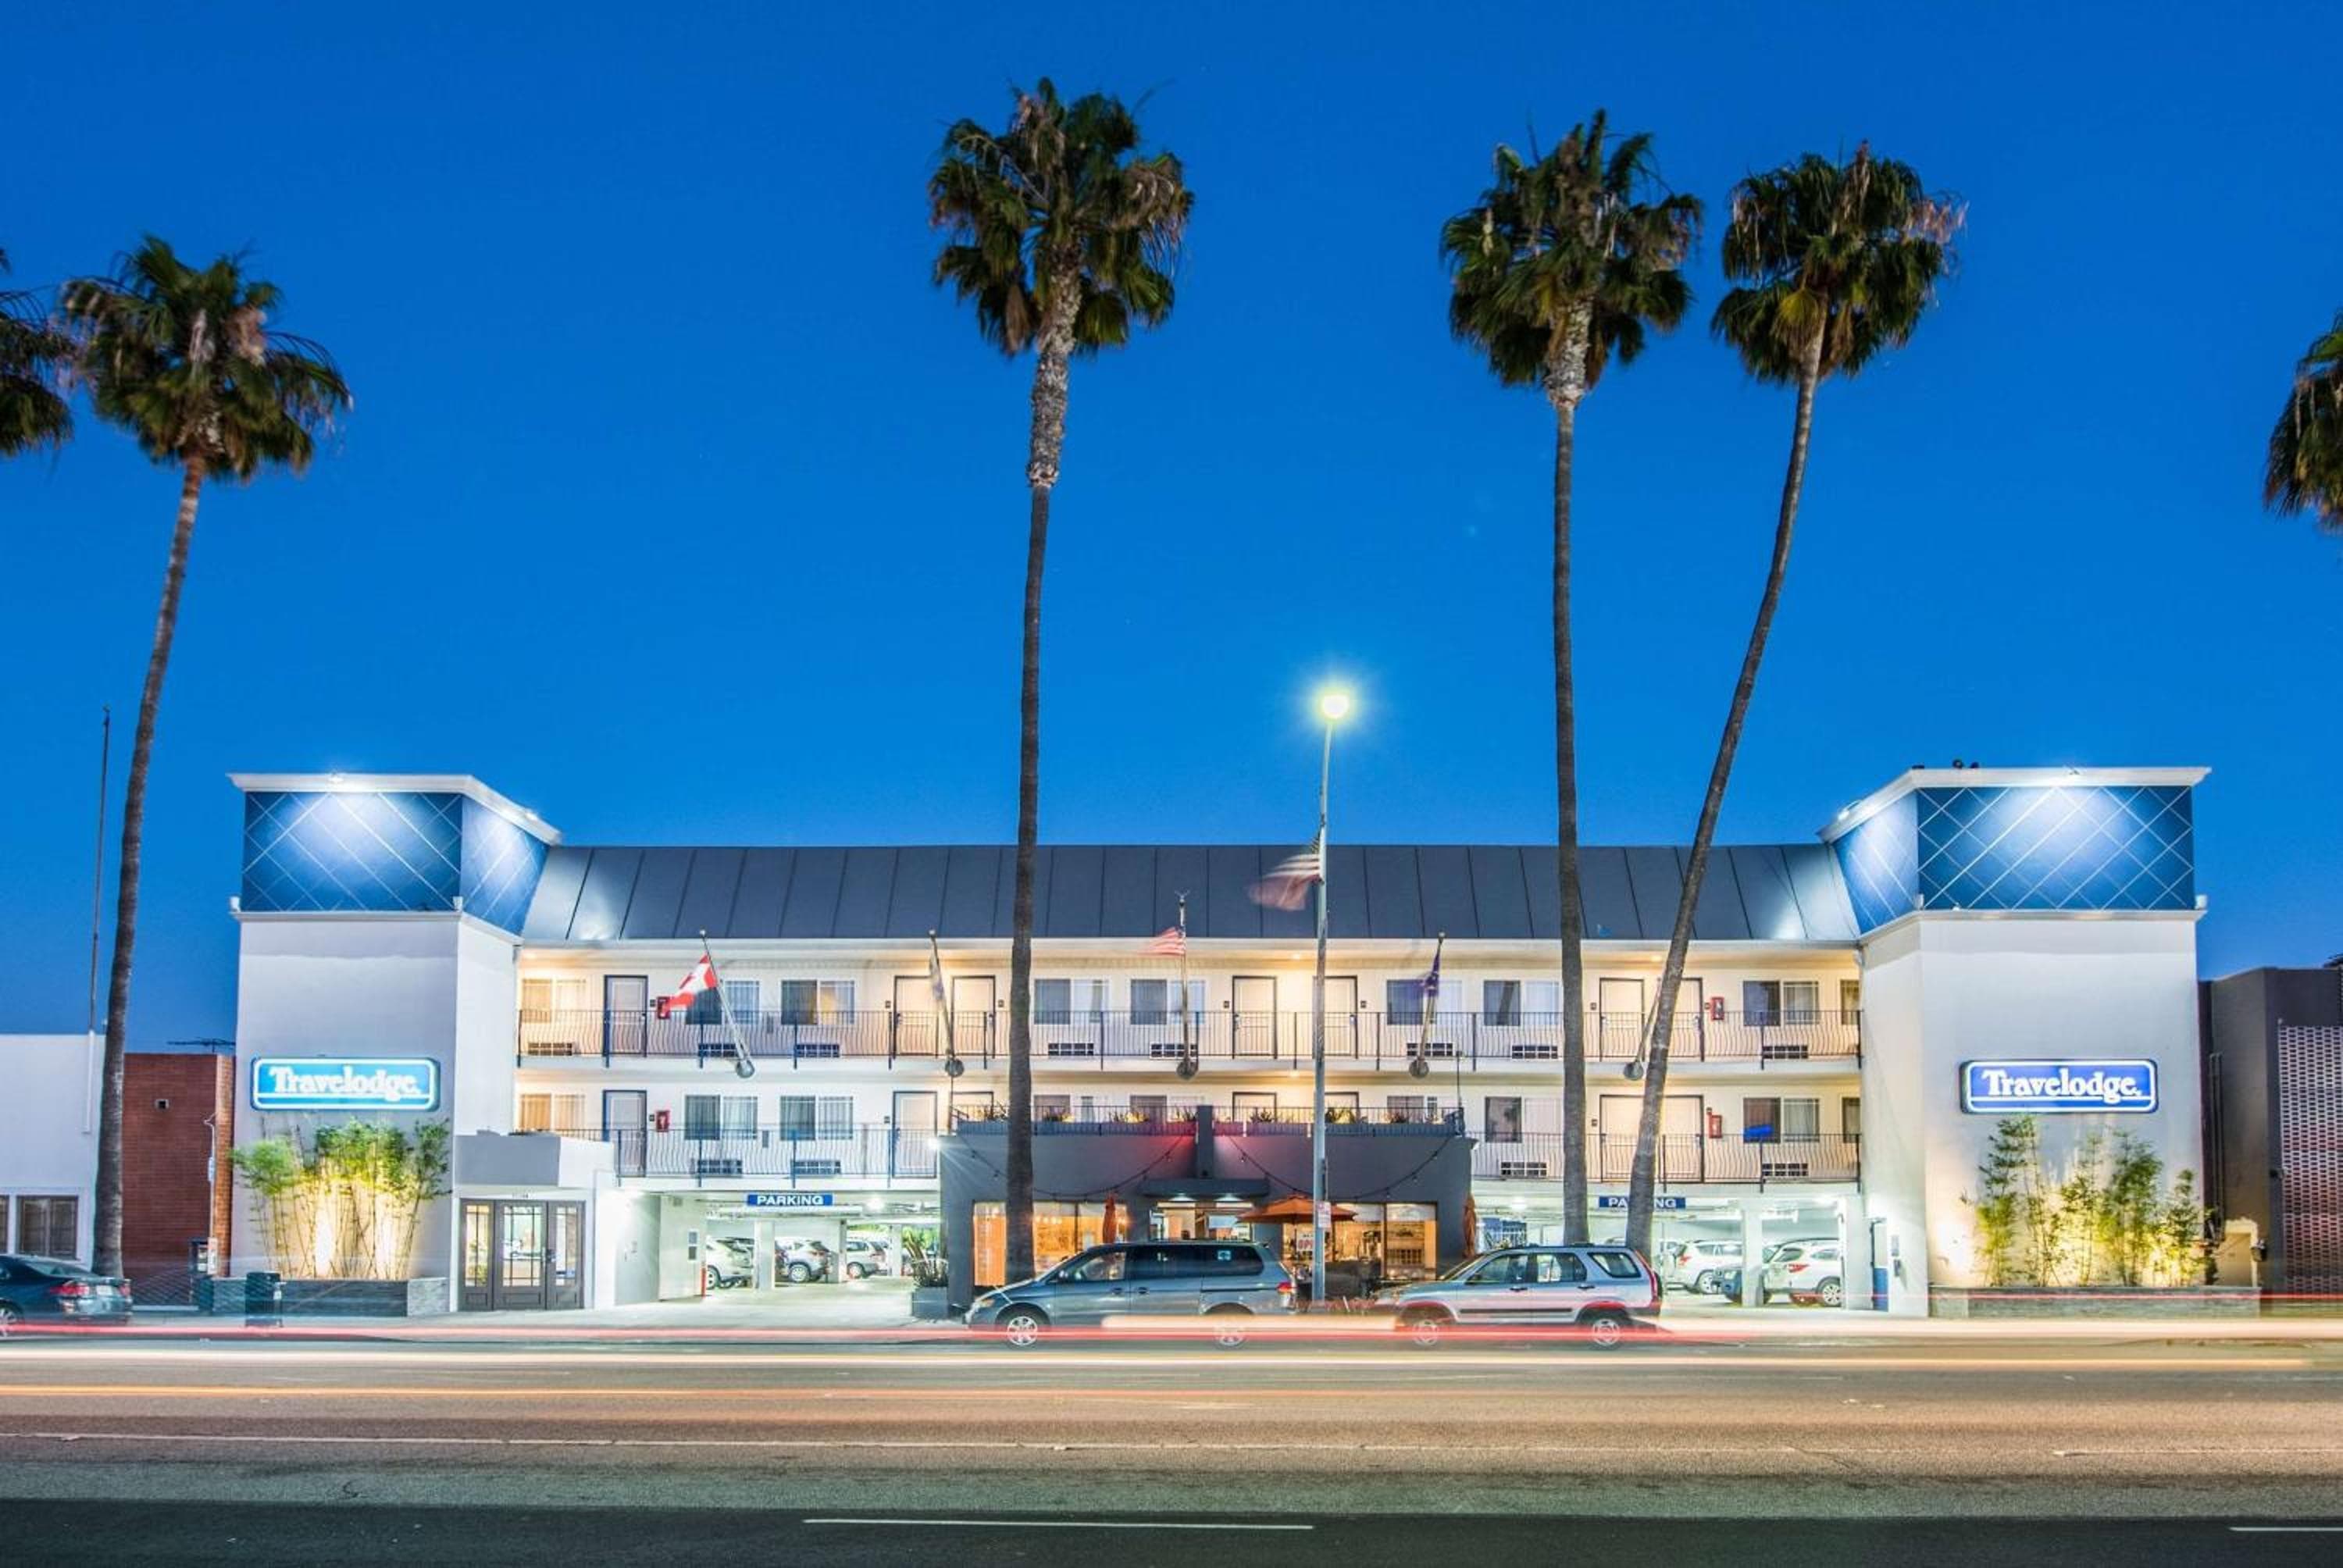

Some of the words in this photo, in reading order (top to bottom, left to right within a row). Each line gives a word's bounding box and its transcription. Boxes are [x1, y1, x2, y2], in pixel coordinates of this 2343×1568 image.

[268, 1065, 418, 1102] Travelodge
[1981, 1067, 2138, 1104] Travelodge
[756, 1195, 824, 1205] PARKING
[1608, 1197, 1677, 1208] PANG
